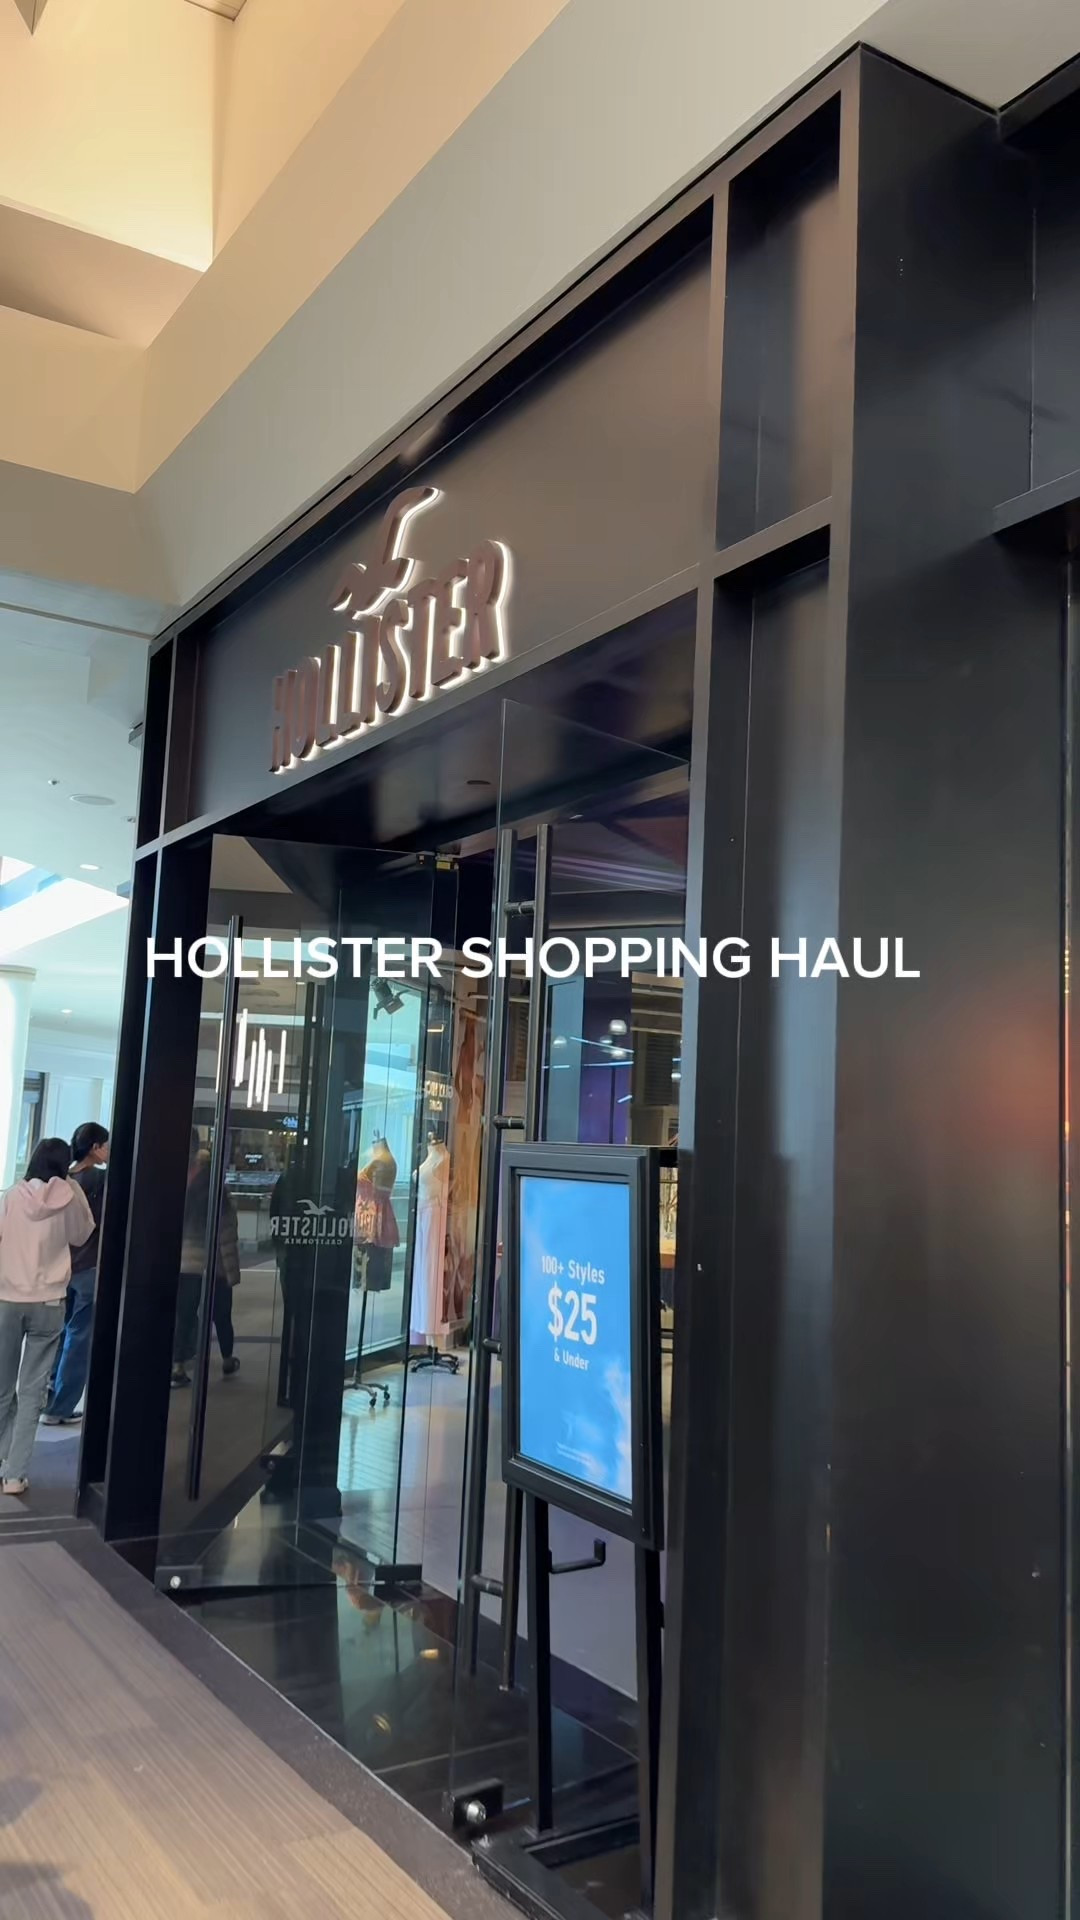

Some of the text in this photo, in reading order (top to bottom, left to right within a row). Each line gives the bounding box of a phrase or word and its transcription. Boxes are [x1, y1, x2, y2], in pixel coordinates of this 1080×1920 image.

[270, 540, 510, 773] HOLLISTER
[541, 1255, 605, 1286] 100+ Styles
[547, 1281, 598, 1345] $25
[554, 1346, 590, 1371] & Under
